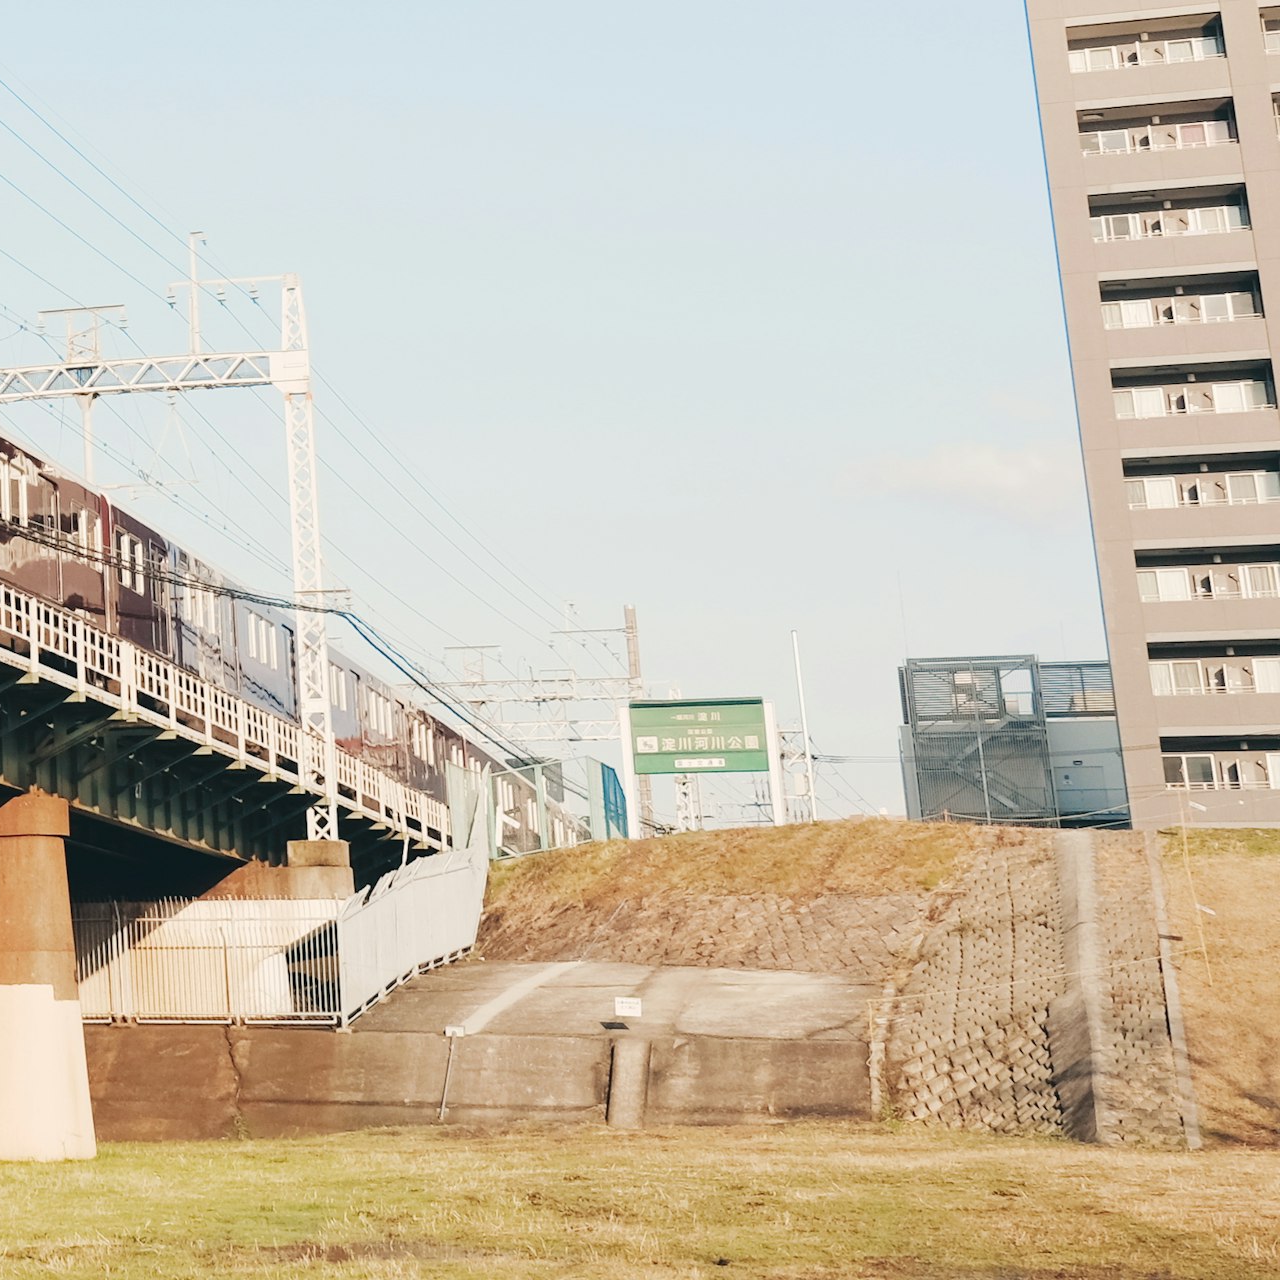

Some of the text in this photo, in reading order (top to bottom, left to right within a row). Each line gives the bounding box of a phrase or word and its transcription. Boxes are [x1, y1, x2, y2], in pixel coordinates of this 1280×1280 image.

[661, 735, 760, 752] 淀川河川公園
